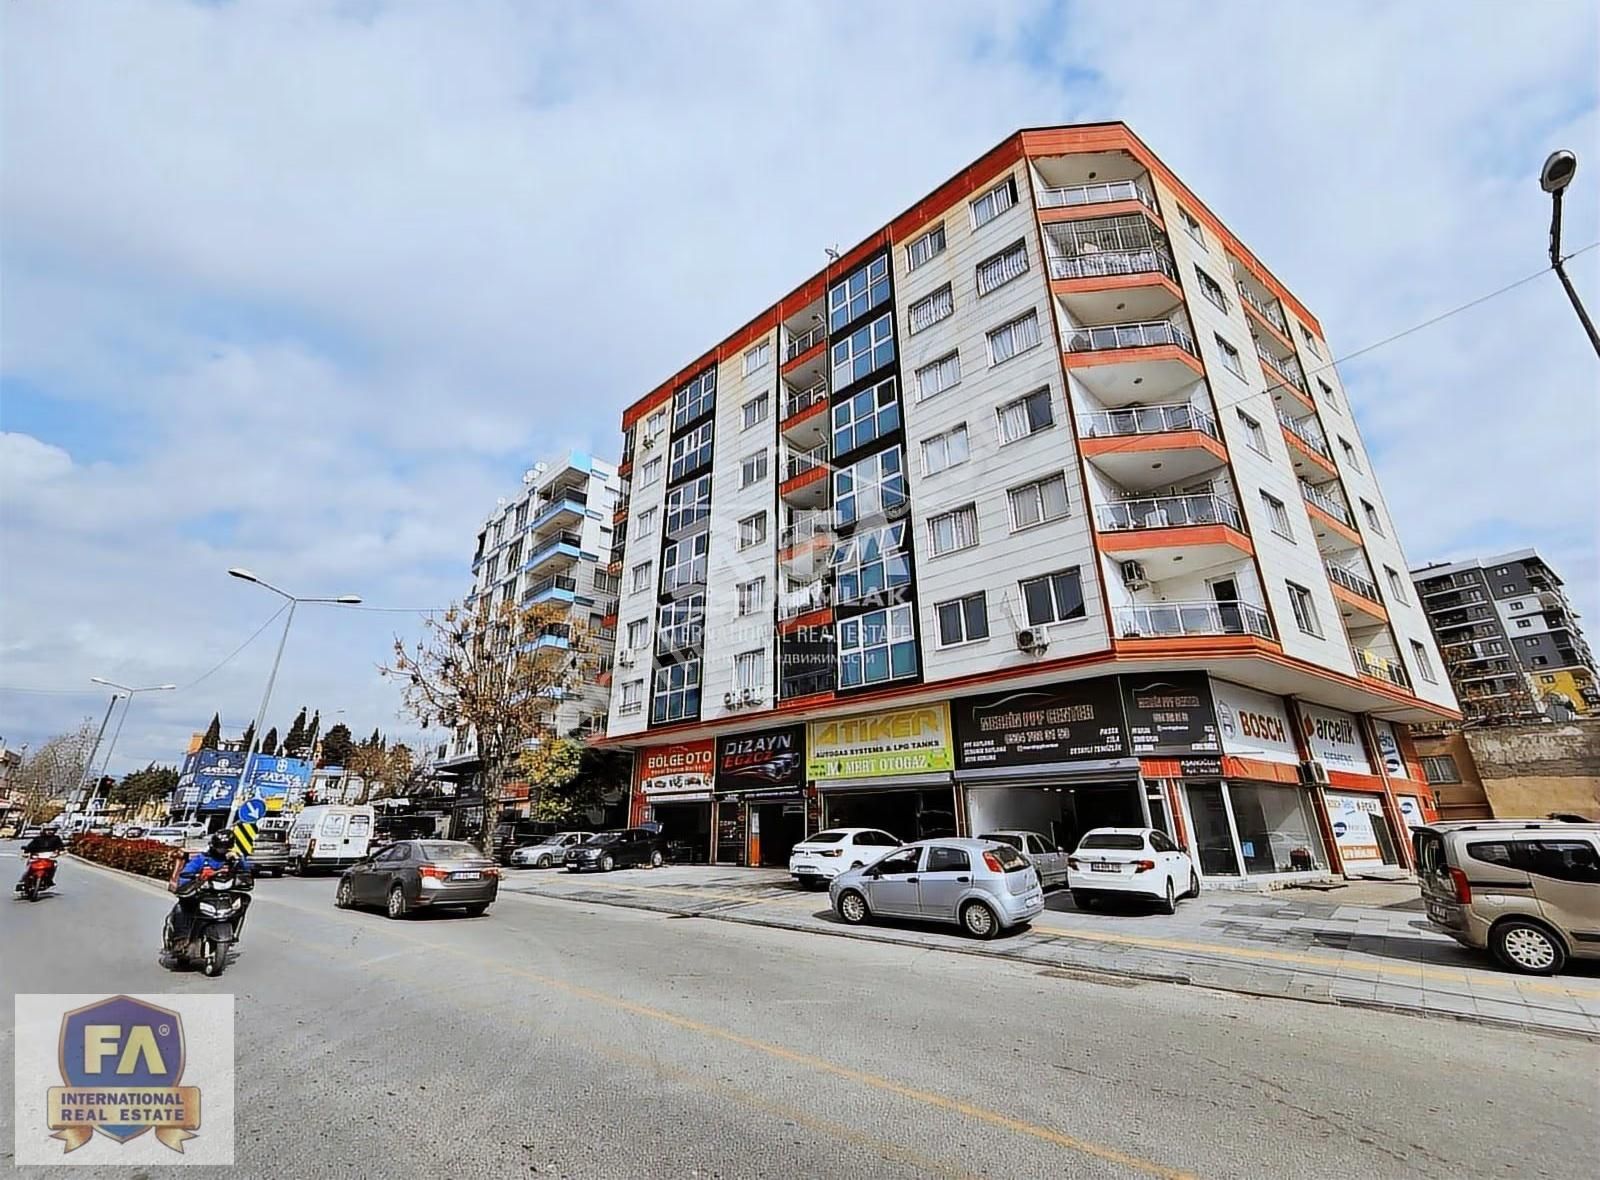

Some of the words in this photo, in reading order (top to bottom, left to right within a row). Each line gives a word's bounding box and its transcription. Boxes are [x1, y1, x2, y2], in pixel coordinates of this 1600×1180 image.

[1239, 710, 1287, 743] BOSCH
[1316, 718, 1356, 747] arçelik
[685, 751, 712, 766] OTO
[815, 749, 849, 758] AUTOGAS
[849, 746, 884, 756] SYSTEMS
[893, 742, 910, 751] LPG
[912, 740, 940, 749] TANKS
